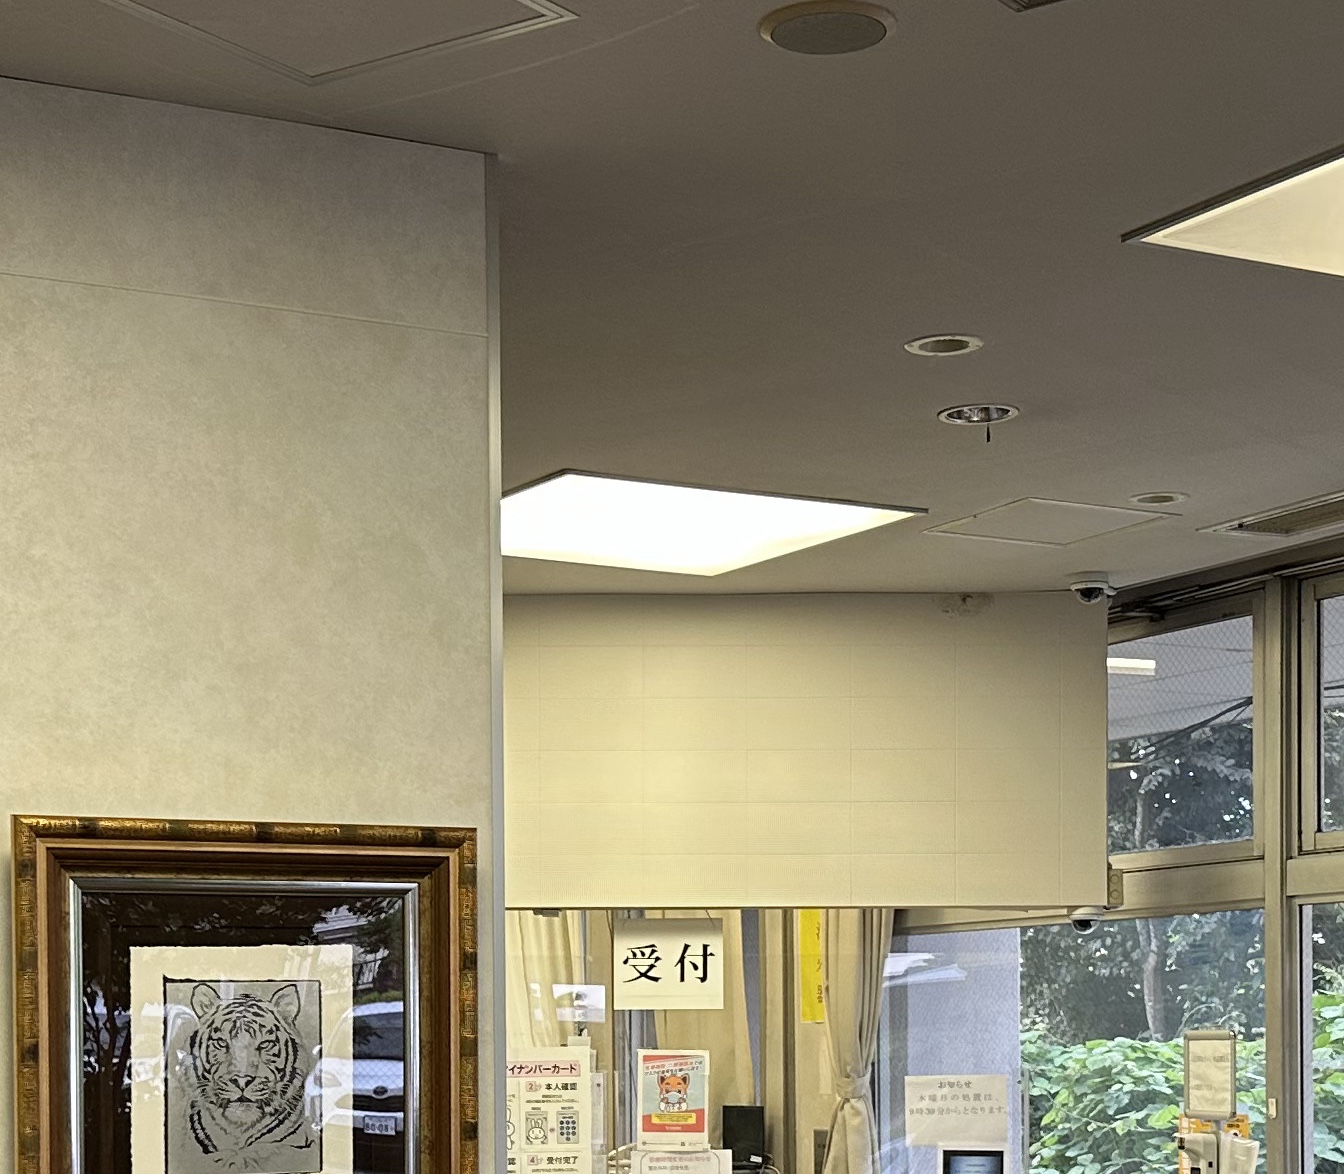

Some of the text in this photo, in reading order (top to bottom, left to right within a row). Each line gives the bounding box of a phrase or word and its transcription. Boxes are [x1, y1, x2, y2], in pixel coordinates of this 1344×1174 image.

[622, 943, 716, 984] 受付
[506, 1064, 577, 1076] イナンバーカード
[544, 1082, 578, 1091] 本人確認
[546, 1156, 579, 1165] 受付完了
